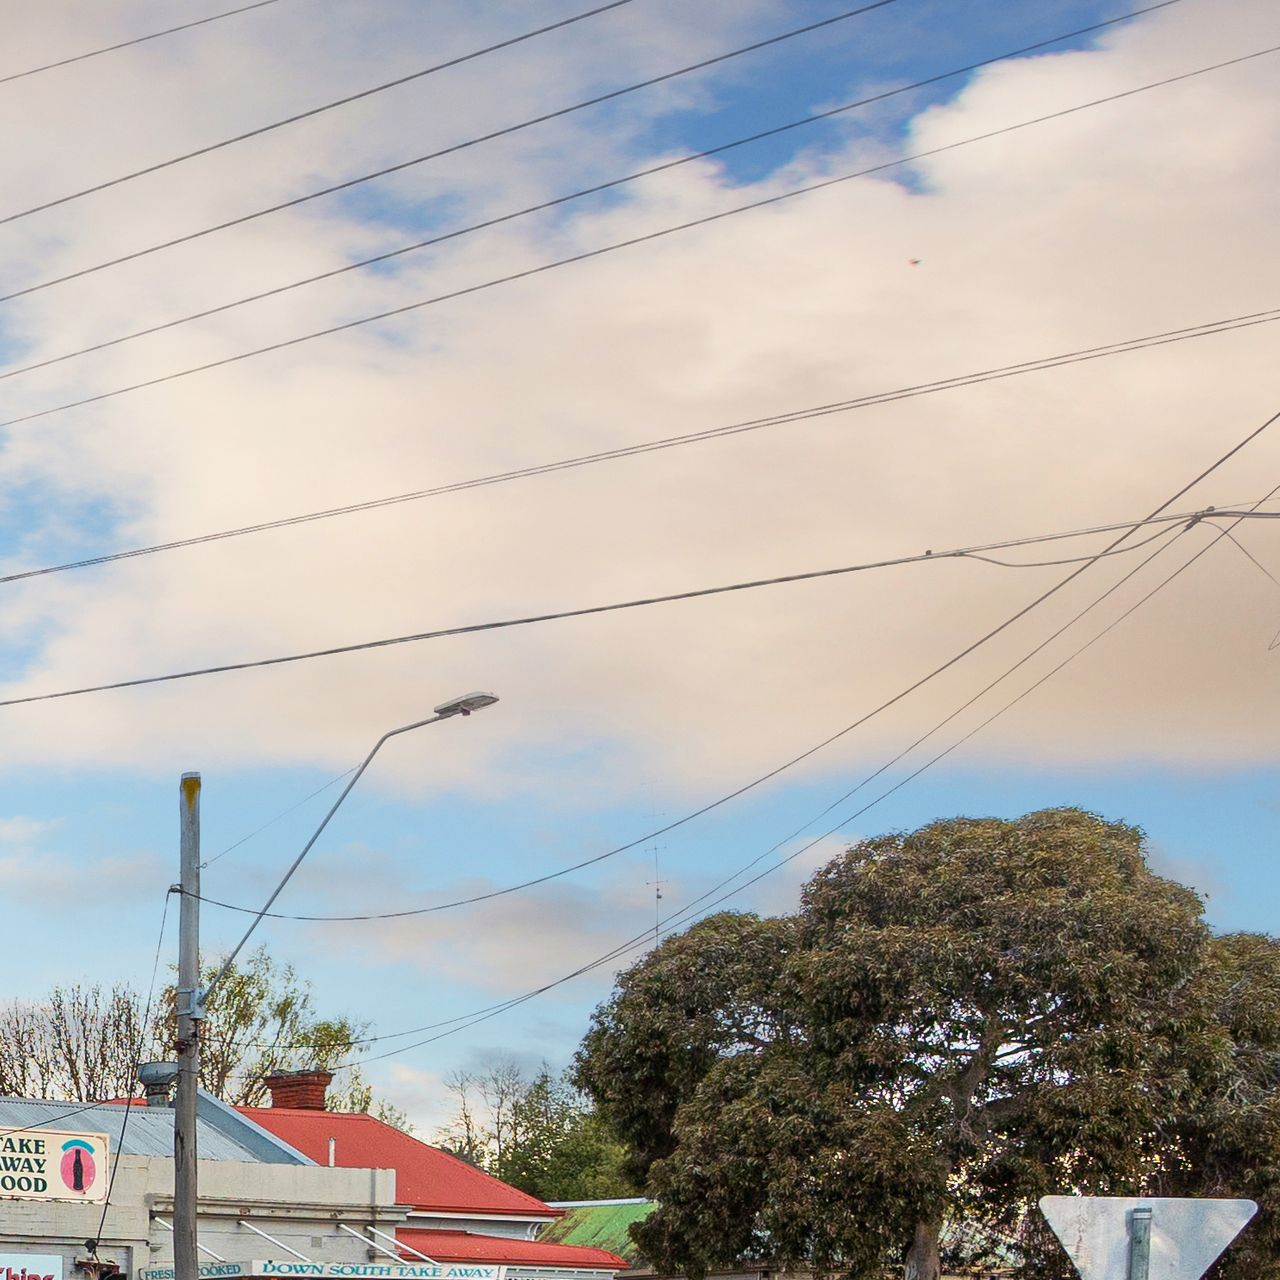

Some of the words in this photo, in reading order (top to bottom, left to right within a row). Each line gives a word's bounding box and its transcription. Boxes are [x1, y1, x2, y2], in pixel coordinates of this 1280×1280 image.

[197, 1264, 241, 1277] OOKED
[262, 1262, 324, 1276] DOWN
[329, 1264, 391, 1277] SOUTH
[396, 1266, 441, 1277] TAKE
[447, 1268, 493, 1279] AWAY
